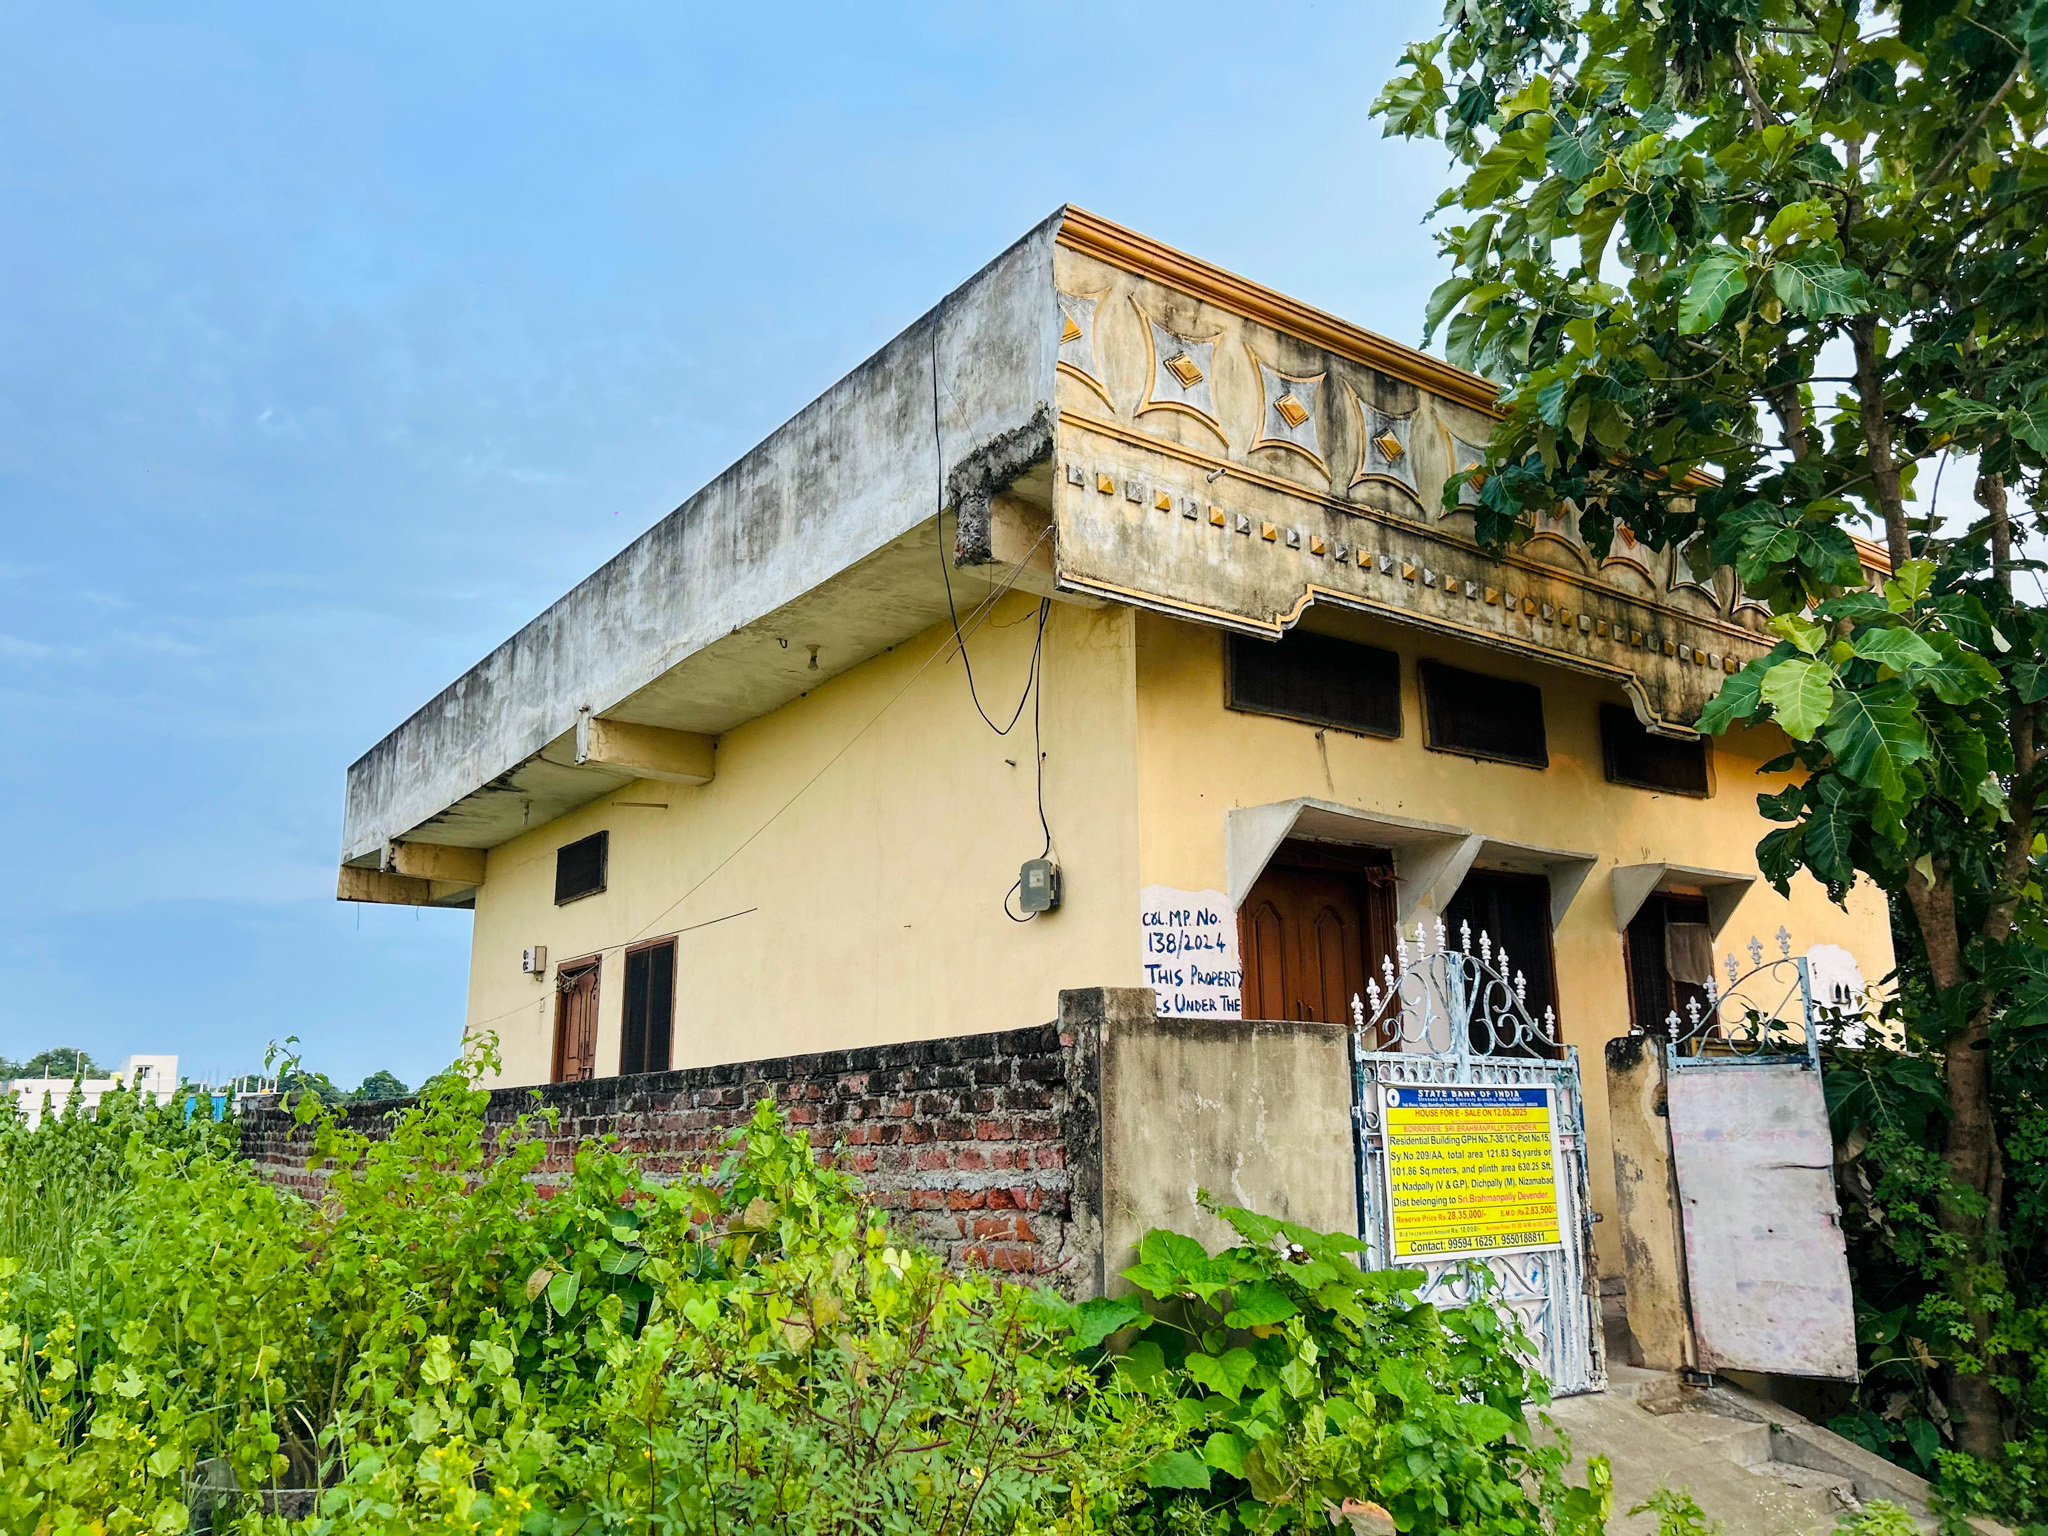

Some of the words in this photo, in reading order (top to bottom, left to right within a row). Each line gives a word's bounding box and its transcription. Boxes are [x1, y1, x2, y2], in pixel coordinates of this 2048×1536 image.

[1196, 908, 1221, 926] No.
[1149, 930, 1226, 959] 138/2024
[1144, 964, 1184, 987] THIS
[1190, 964, 1244, 988] PROPERTY
[1174, 993, 1218, 1013] UNDER
[1219, 995, 1241, 1012] THE
[1418, 1089, 1447, 1097] STATE
[1415, 1109, 1439, 1117] HOUSE
[1440, 1109, 1454, 1117] FOR
[1455, 1109, 1460, 1117] E
[1493, 1108, 1527, 1116] 12.05.2025
[1506, 1123, 1537, 1131] DEVENDER
[1390, 1136, 1430, 1145] Residential
[1430, 1135, 1460, 1146] Building
[1461, 1135, 1477, 1144] GPH
[1518, 1134, 1531, 1142] Plot
[1447, 1150, 1464, 1159] total
[1486, 1149, 1509, 1157] 121.83
[1511, 1148, 1541, 1159] Sq.yards
[1392, 1167, 1417, 1176] 101.86
[1419, 1166, 1459, 1176] Sq.meters,
[1462, 1164, 1475, 1173] and
[1478, 1164, 1498, 1174] plinth
[1517, 1162, 1539, 1171] 630.25
[1392, 1183, 1400, 1191] at
[1402, 1181, 1434, 1192] Nadpally
[1436, 1181, 1443, 1191] (V
[1445, 1180, 1451, 1189] &
[1471, 1178, 1502, 1189] Dichpally
[1518, 1176, 1554, 1185] Nizamabad
[1393, 1197, 1409, 1206] Dist
[1411, 1196, 1447, 1207] belonging
[1449, 1196, 1456, 1204] to
[1422, 1214, 1437, 1222] Price
[1409, 1229, 1434, 1237] Increment
[1410, 1241, 1446, 1252] Contact:
[1448, 1238, 1473, 1249] 99594
